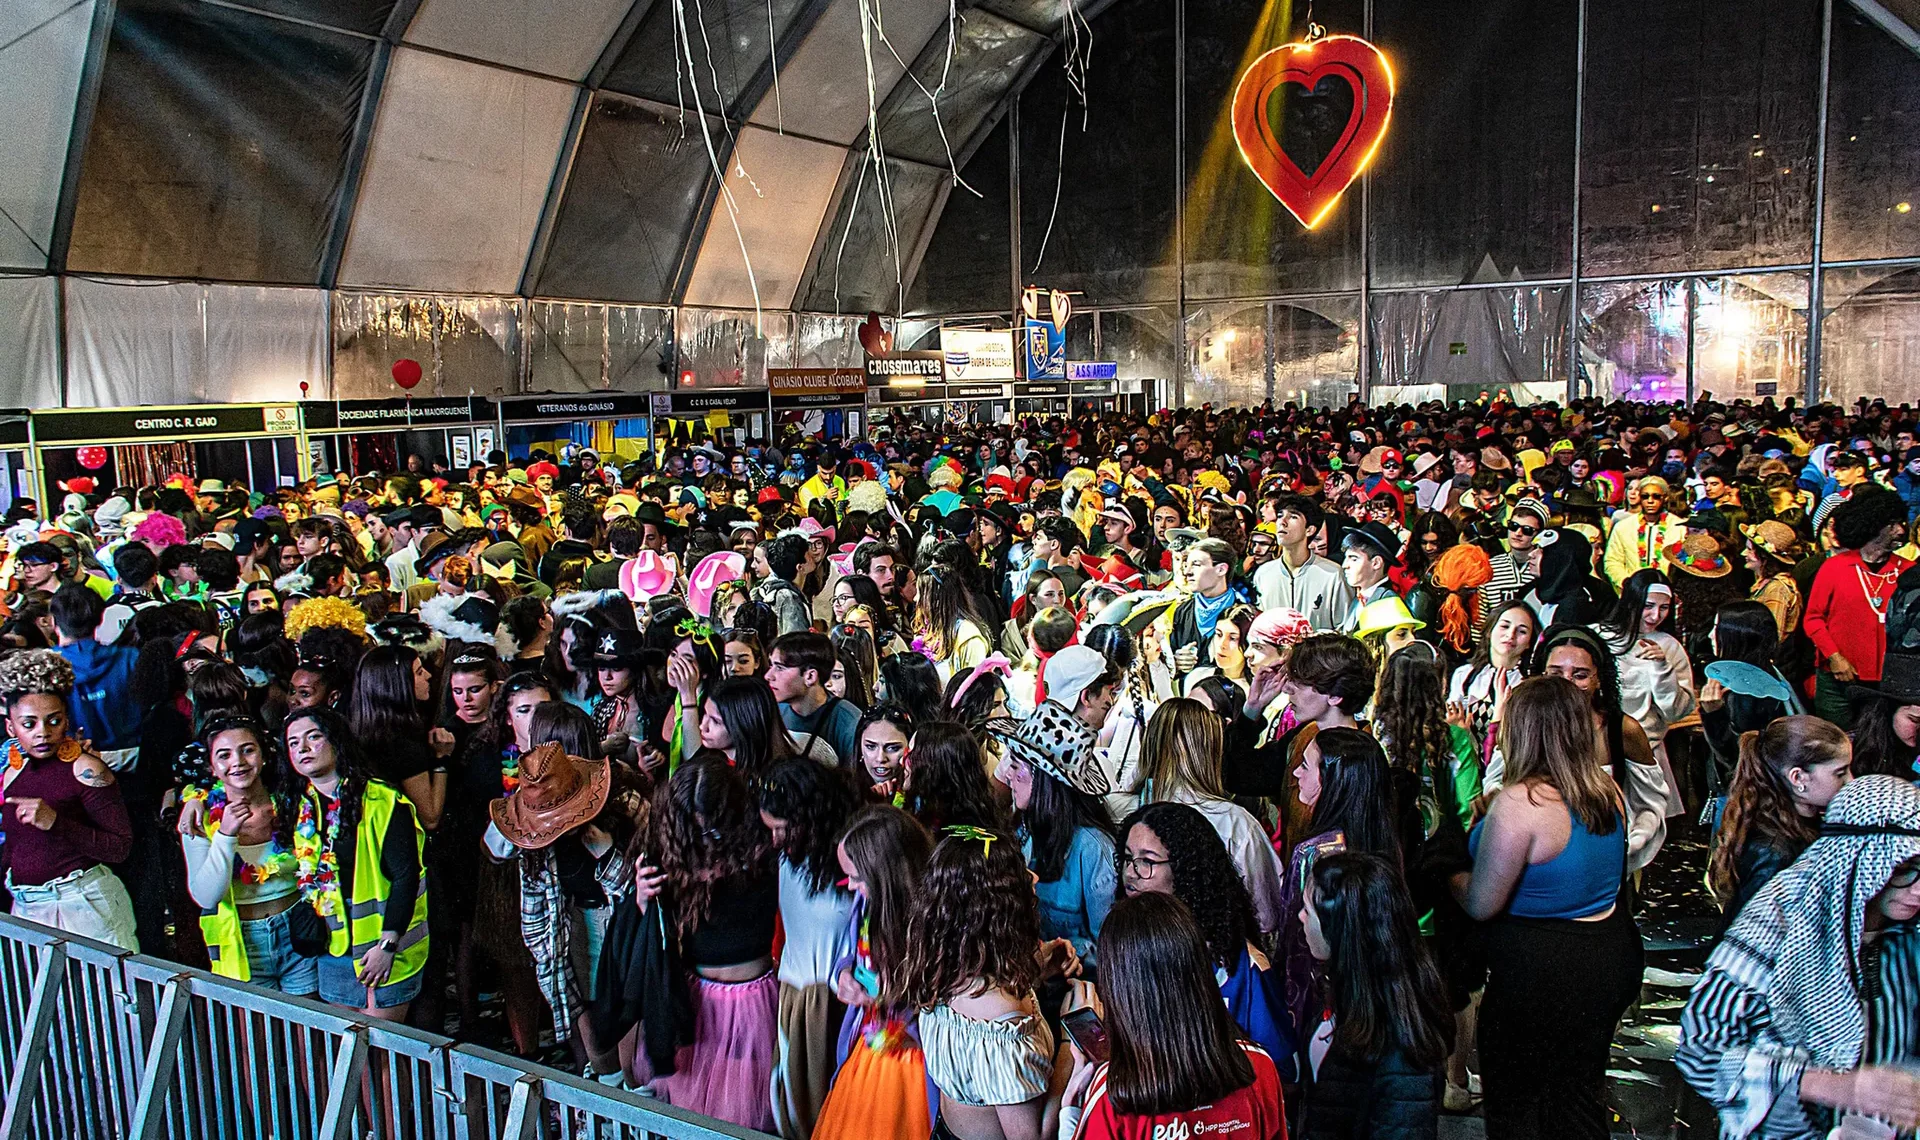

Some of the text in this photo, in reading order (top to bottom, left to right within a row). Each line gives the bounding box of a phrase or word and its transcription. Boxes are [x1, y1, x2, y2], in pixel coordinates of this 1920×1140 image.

[772, 373, 864, 389] GINÁSIO CLUBE ALCOBAÇA
[536, 403, 578, 413] VETERANOS
[588, 401, 615, 411] GINÁSIO
[339, 409, 379, 420] SOCIEDADE
[134, 418, 173, 430] CENTRO
[195, 416, 218, 427] GAIO
